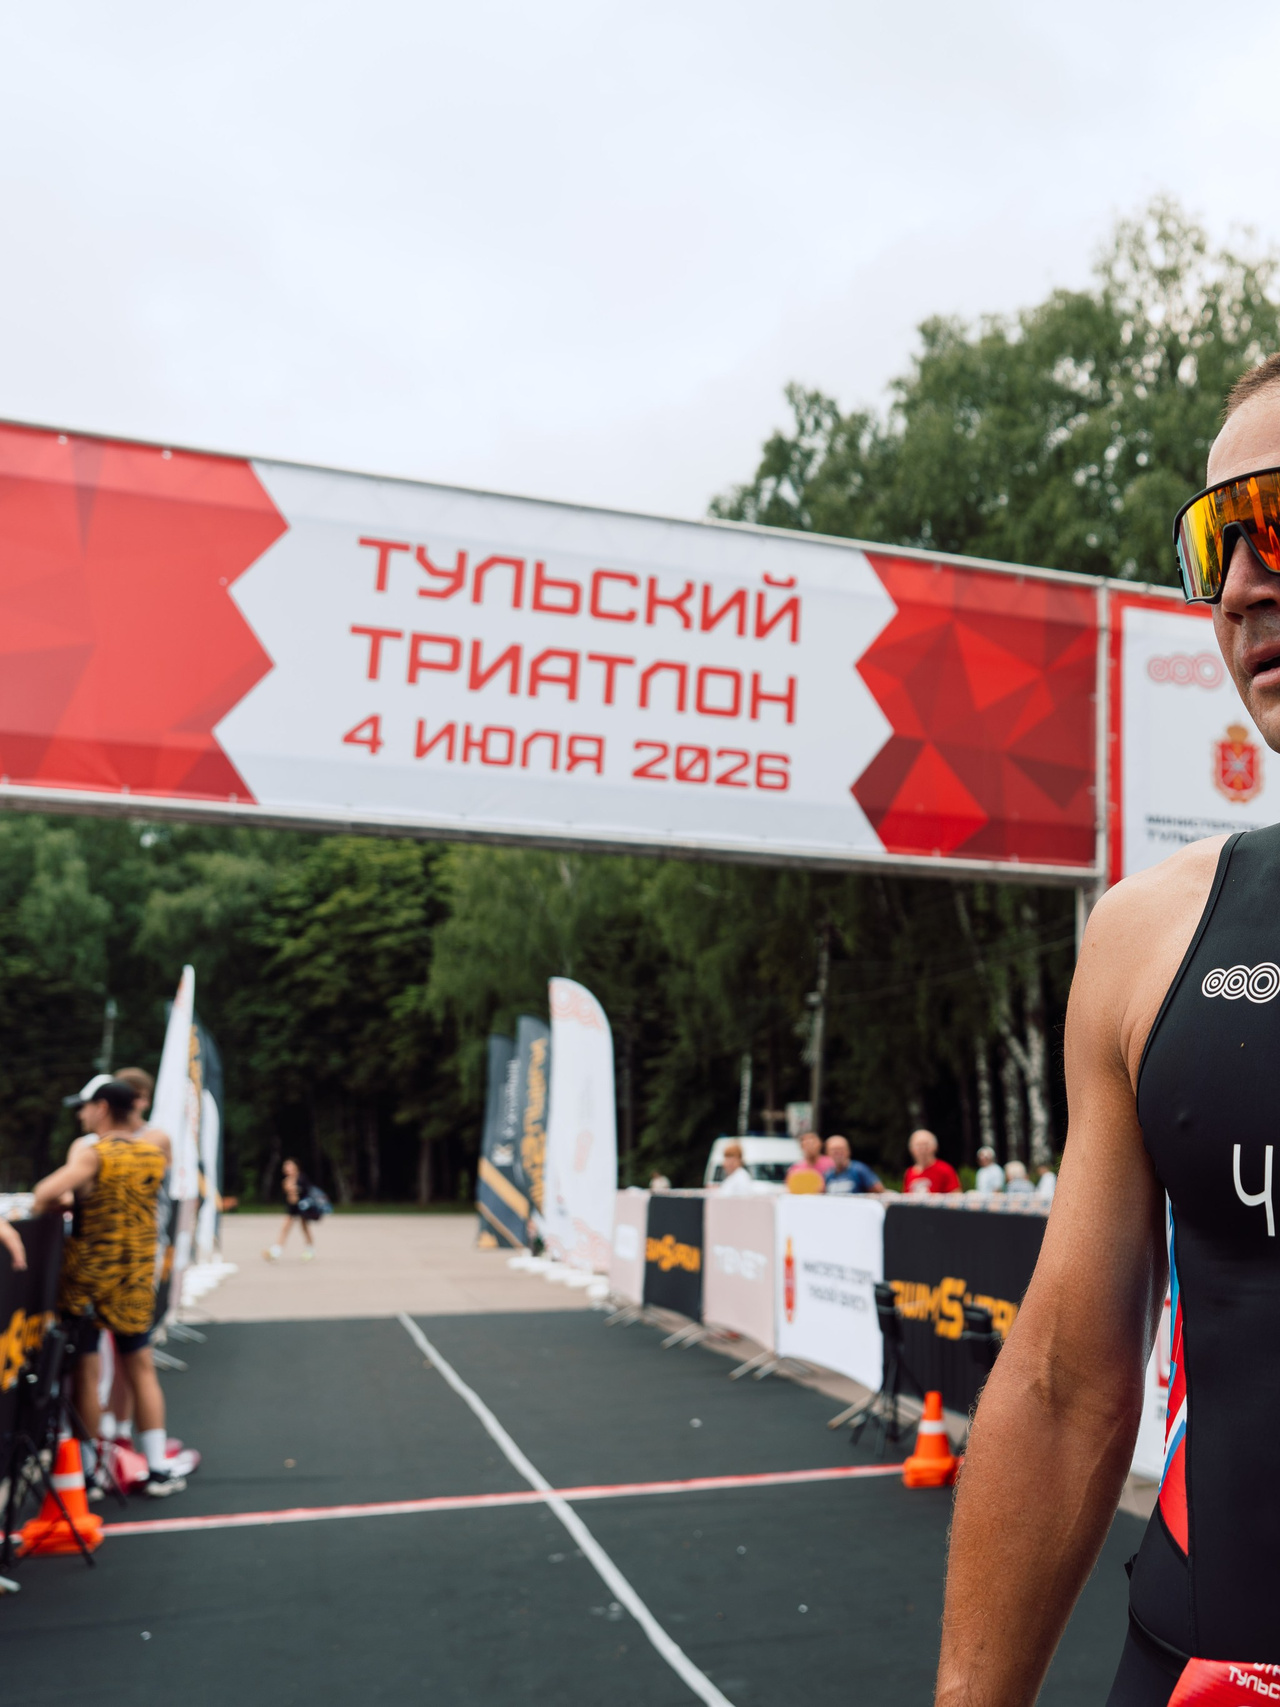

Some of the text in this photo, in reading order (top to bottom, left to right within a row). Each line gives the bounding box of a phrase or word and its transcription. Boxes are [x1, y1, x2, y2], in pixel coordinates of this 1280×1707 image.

[358, 536, 801, 644] ТУЛЬСКИЙ
[350, 624, 797, 725] ТРИАТЛОН
[342, 714, 791, 792] 4 ИЮЛЯ 2026
